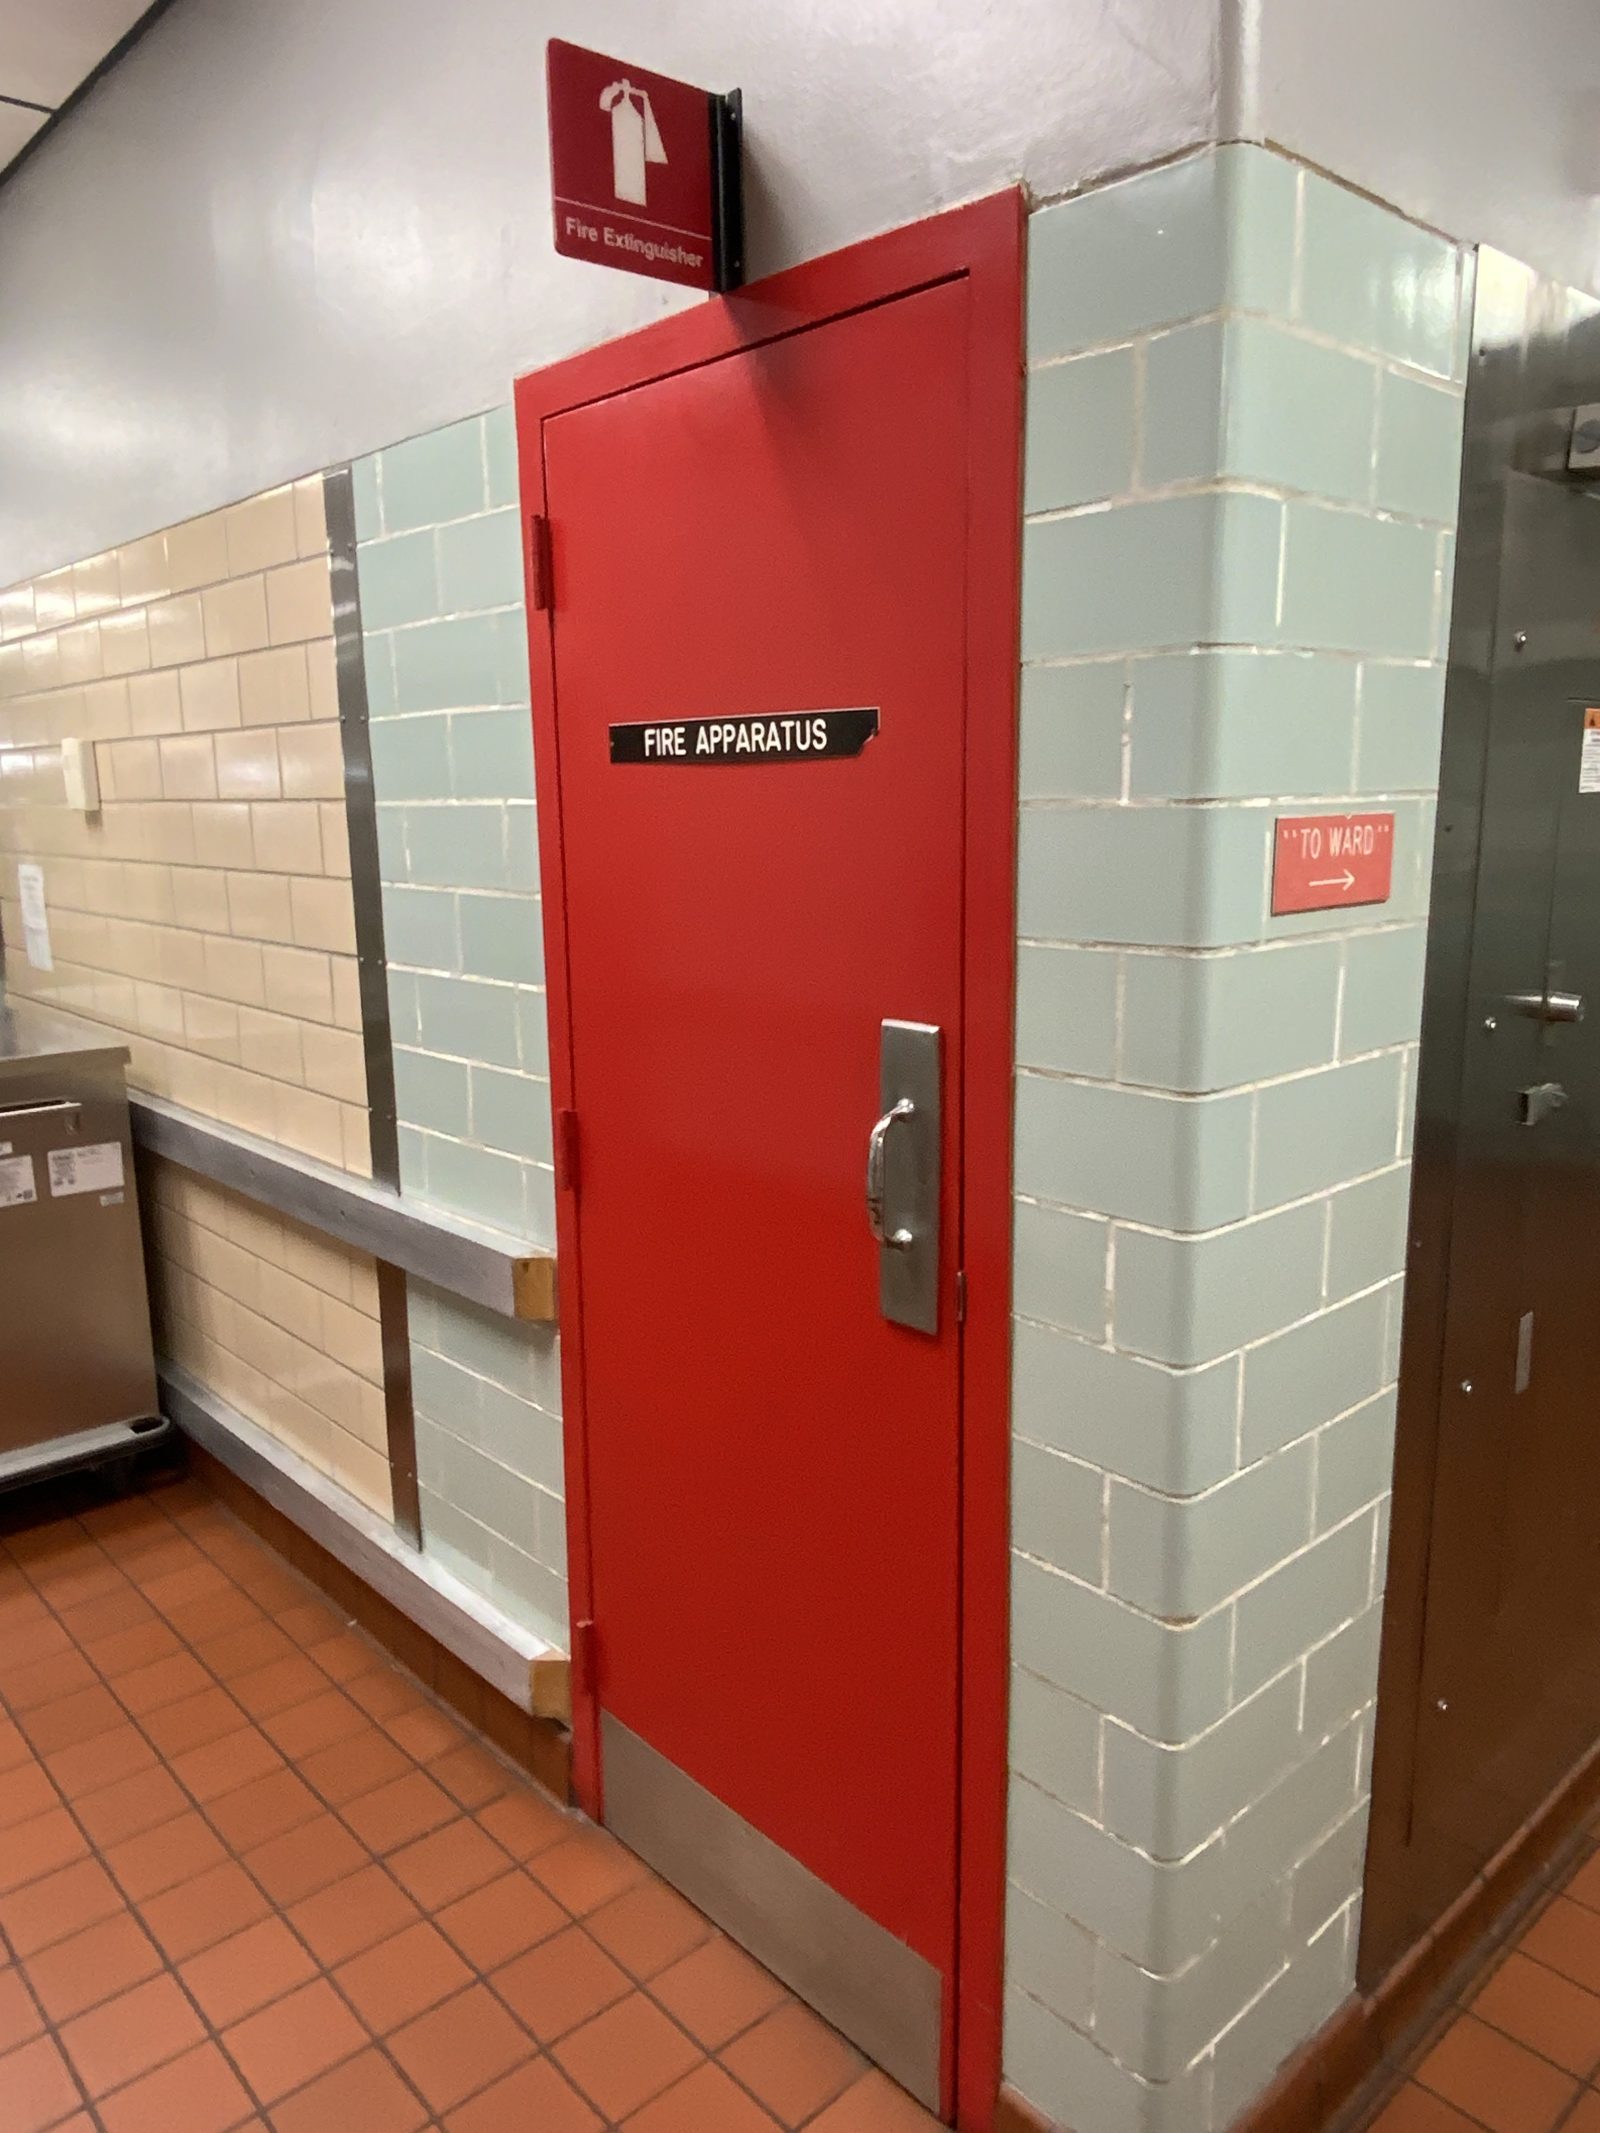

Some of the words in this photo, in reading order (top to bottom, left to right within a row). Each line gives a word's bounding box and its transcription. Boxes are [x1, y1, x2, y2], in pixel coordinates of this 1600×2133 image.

[565, 216, 598, 242] Fire
[603, 227, 704, 268] Extinguisher
[643, 726, 687, 757] FIRE
[695, 718, 828, 755] APPARATUS
